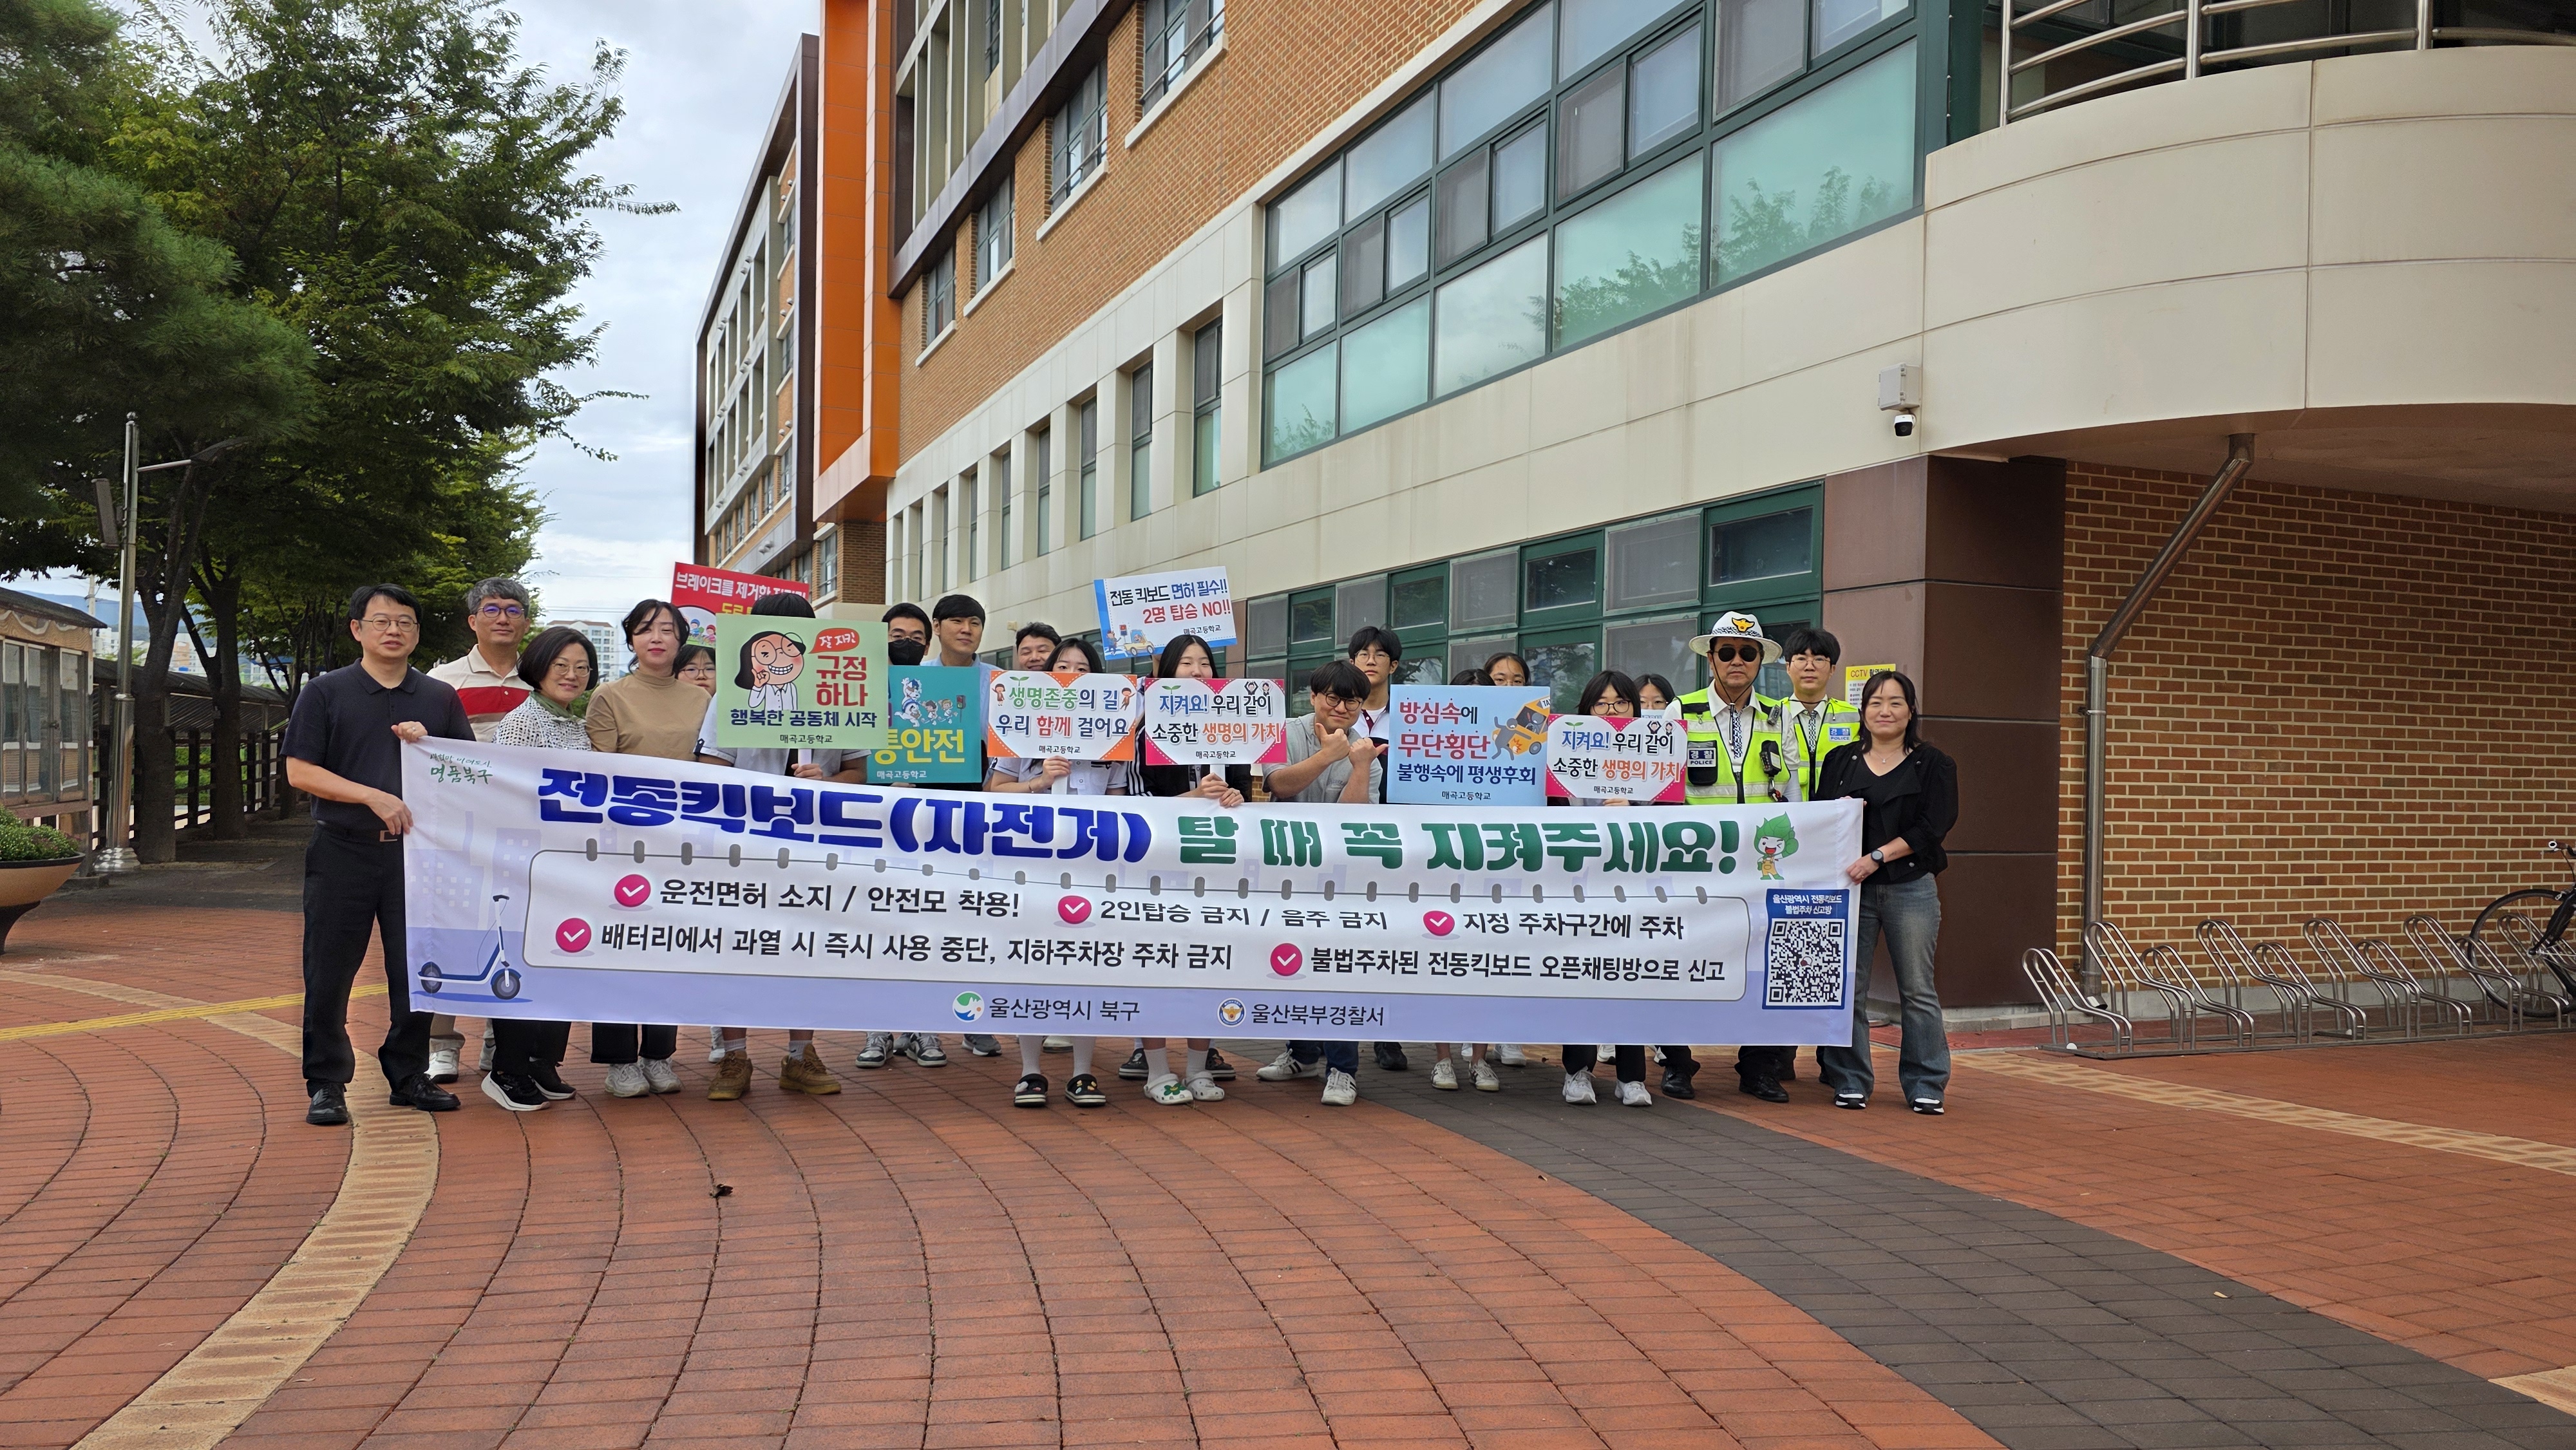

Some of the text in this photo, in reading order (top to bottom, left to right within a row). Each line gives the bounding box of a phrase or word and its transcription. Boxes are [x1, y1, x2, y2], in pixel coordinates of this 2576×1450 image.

[675, 572, 734, 597] 브레이크를
[1110, 579, 1228, 607] 전동 킥보드 면허 필수!!
[1142, 599, 1231, 624] 2명 탑승 NO!!
[1184, 625, 1221, 635] 매곡고등학교
[819, 636, 833, 648] 잘
[816, 655, 867, 681] 규정
[816, 681, 868, 707] 하나
[1009, 687, 1118, 710] 생명존중의 길
[1159, 694, 1271, 715] 지켜요! 우리 같이
[730, 709, 877, 728] 행복한 공동체 시작
[1399, 702, 1478, 724] 방심속에
[996, 714, 1129, 738] 우리 함께 걸어요
[1151, 722, 1280, 743] 소중한 생명의 가치
[780, 734, 833, 744] 매곡고등학교
[1039, 746, 1081, 754] 매곡고등학교
[1397, 733, 1490, 760] 무단횡단
[1562, 731, 1673, 754] 지켜요! 우리 같이
[1196, 751, 1236, 759] 매곡고등학교
[431, 764, 493, 784] 명품북구
[876, 771, 927, 780] 매곡고등학교
[1397, 764, 1536, 786] 불행속에 평생후회
[1552, 757, 1680, 782] 소중한 생명의 가치
[1442, 791, 1491, 801] 매곡고등학교
[1593, 786, 1634, 795] 매곡고등학교
[538, 767, 1739, 875] 전동킥보드(자전거) 탈 때 꼭 지켜주세요!
[659, 878, 768, 909] 운전면허
[778, 883, 832, 911] 소지
[867, 885, 948, 915] 안전모
[957, 892, 1019, 918] 착용!
[1772, 894, 1809, 904] 울산광역시
[1813, 905, 1832, 914] 신고방
[1100, 900, 1191, 923] 2인탑승
[1200, 905, 1251, 926] 금지
[1281, 909, 1331, 928] 음주
[1338, 910, 1388, 930] 금지
[1464, 910, 1684, 940] 지정 주차구간에 주차
[601, 923, 1232, 970] 배터리에서 과열 시 즉시 사용 중단, 지하주차장 주차 금지
[1311, 947, 1725, 982] 불법주차된 전동킥보드 오픈채팅방으로 신고
[989, 997, 1141, 1021] 울산광역시 북구
[1251, 1003, 1384, 1026] 울산북부경찰서
